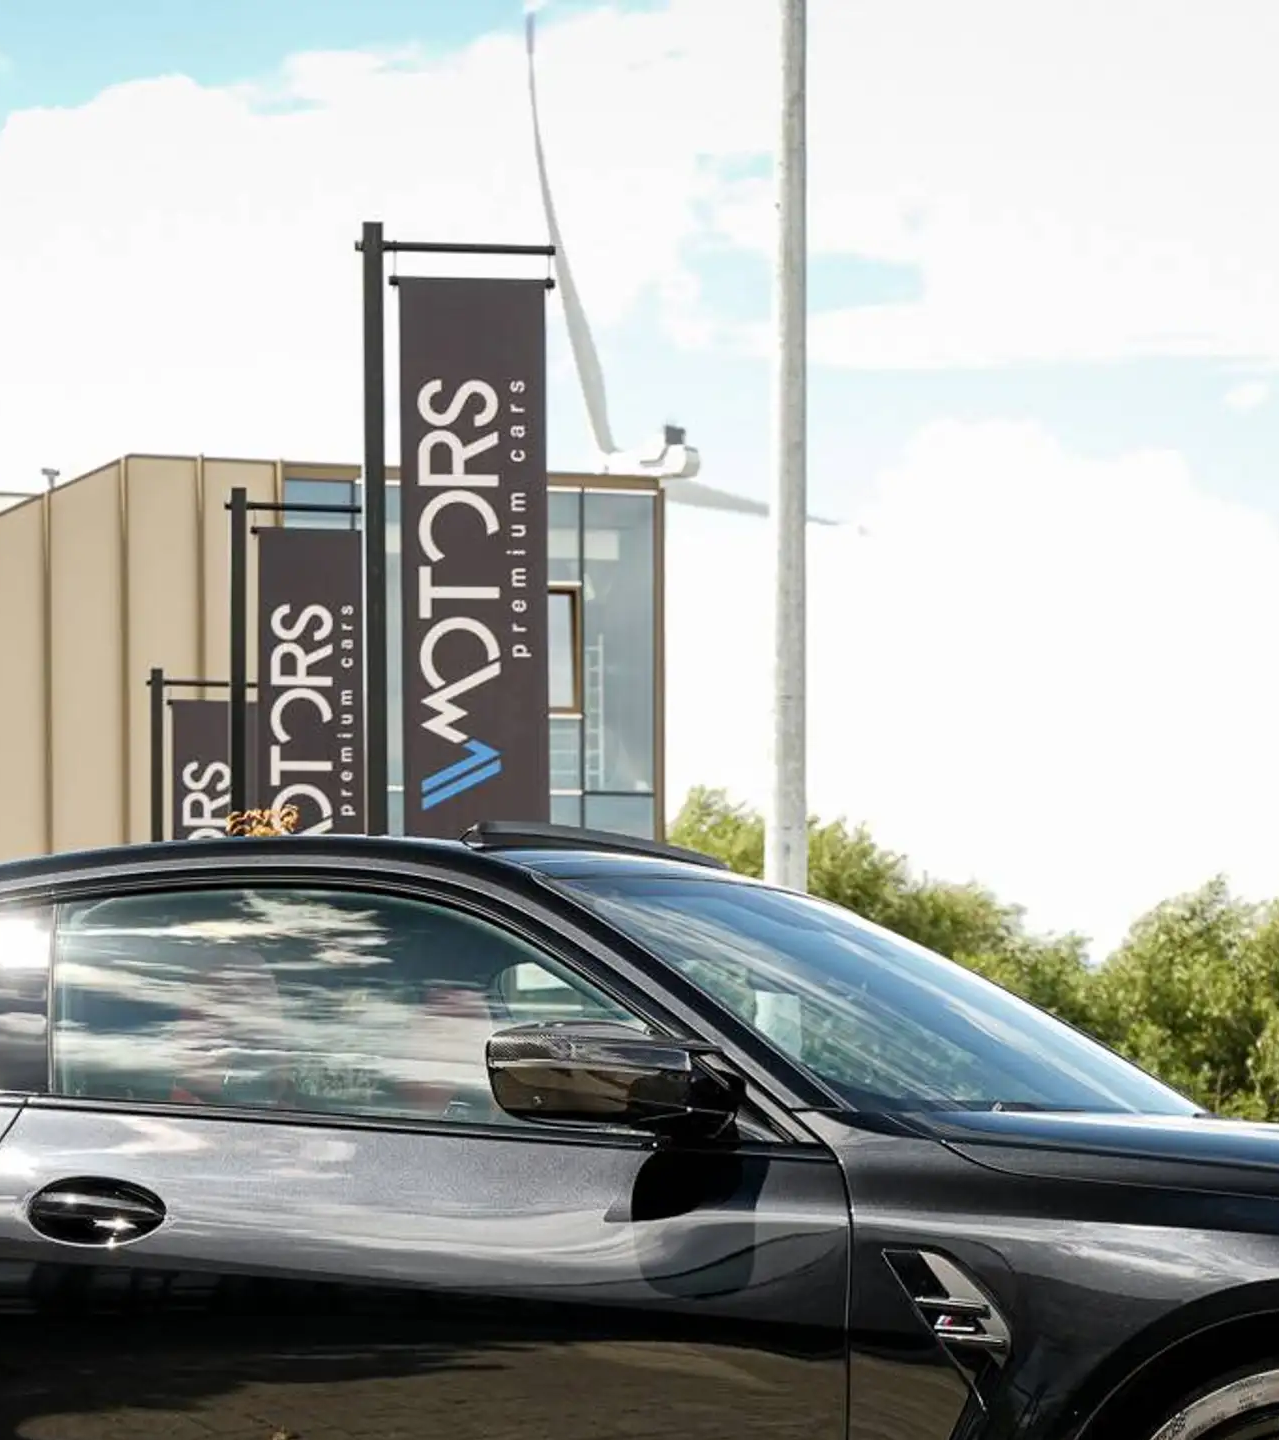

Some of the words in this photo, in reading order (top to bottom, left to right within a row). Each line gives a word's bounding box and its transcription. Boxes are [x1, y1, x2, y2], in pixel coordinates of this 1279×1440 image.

[510, 380, 525, 462] cars
[341, 605, 354, 668] cars
[506, 492, 532, 657] premium
[270, 603, 333, 835] OTORS
[337, 689, 356, 816] premium
